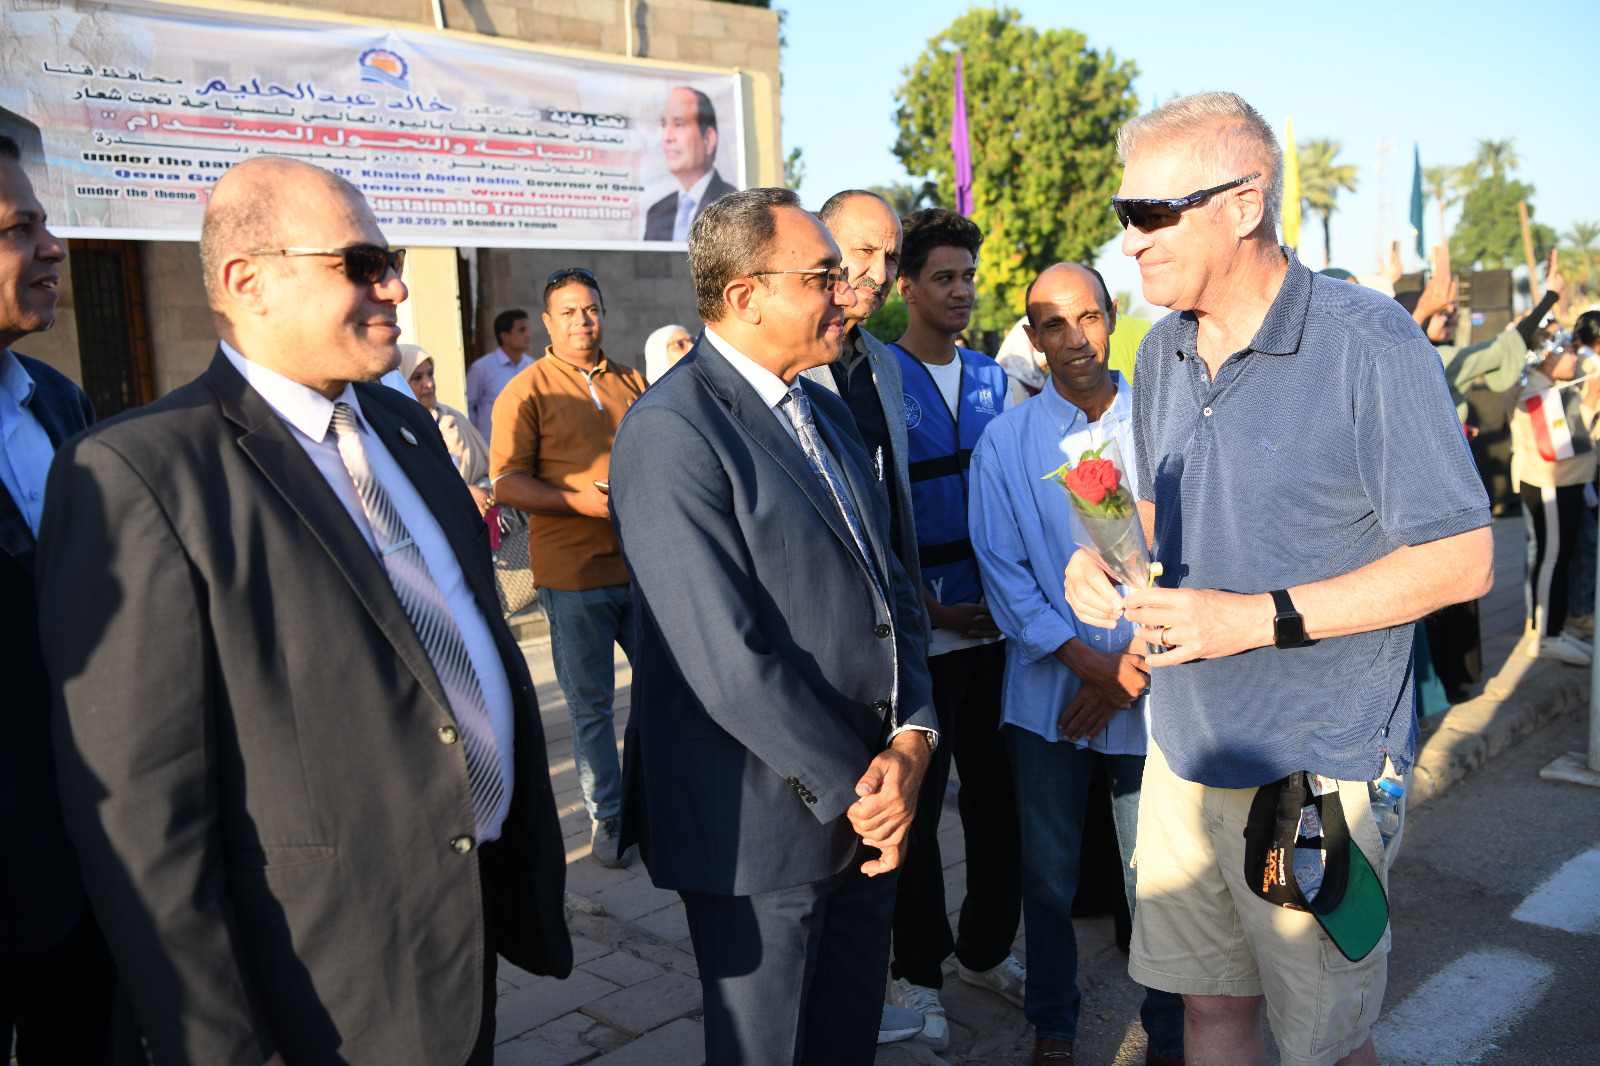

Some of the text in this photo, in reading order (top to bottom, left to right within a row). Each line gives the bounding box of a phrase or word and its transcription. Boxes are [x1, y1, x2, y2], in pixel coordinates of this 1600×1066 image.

[44, 62, 94, 76] قنا
[100, 68, 183, 85] محافظ
[73, 88, 122, 101] شعار
[128, 92, 172, 105] تحت
[388, 94, 453, 112] خالد
[302, 112, 383, 124] العالمي
[449, 121, 486, 132] قنا
[493, 123, 569, 139] محافظة
[126, 113, 593, 161] السياحة والتحول المستدام
[83, 153, 151, 165] under
[158, 157, 192, 167] the
[115, 169, 180, 181] Qena
[362, 170, 421, 180] Khaled
[426, 173, 471, 183] Abdel
[527, 179, 591, 189] Governor
[612, 184, 645, 192] Qena
[77, 186, 120, 197] under
[126, 188, 148, 198] the
[154, 189, 196, 200] theme
[471, 189, 524, 197] World
[531, 192, 597, 200] Tourism
[602, 195, 629, 203] Day
[365, 196, 632, 220] Sustainable Transformation
[518, 220, 557, 229] Temple
